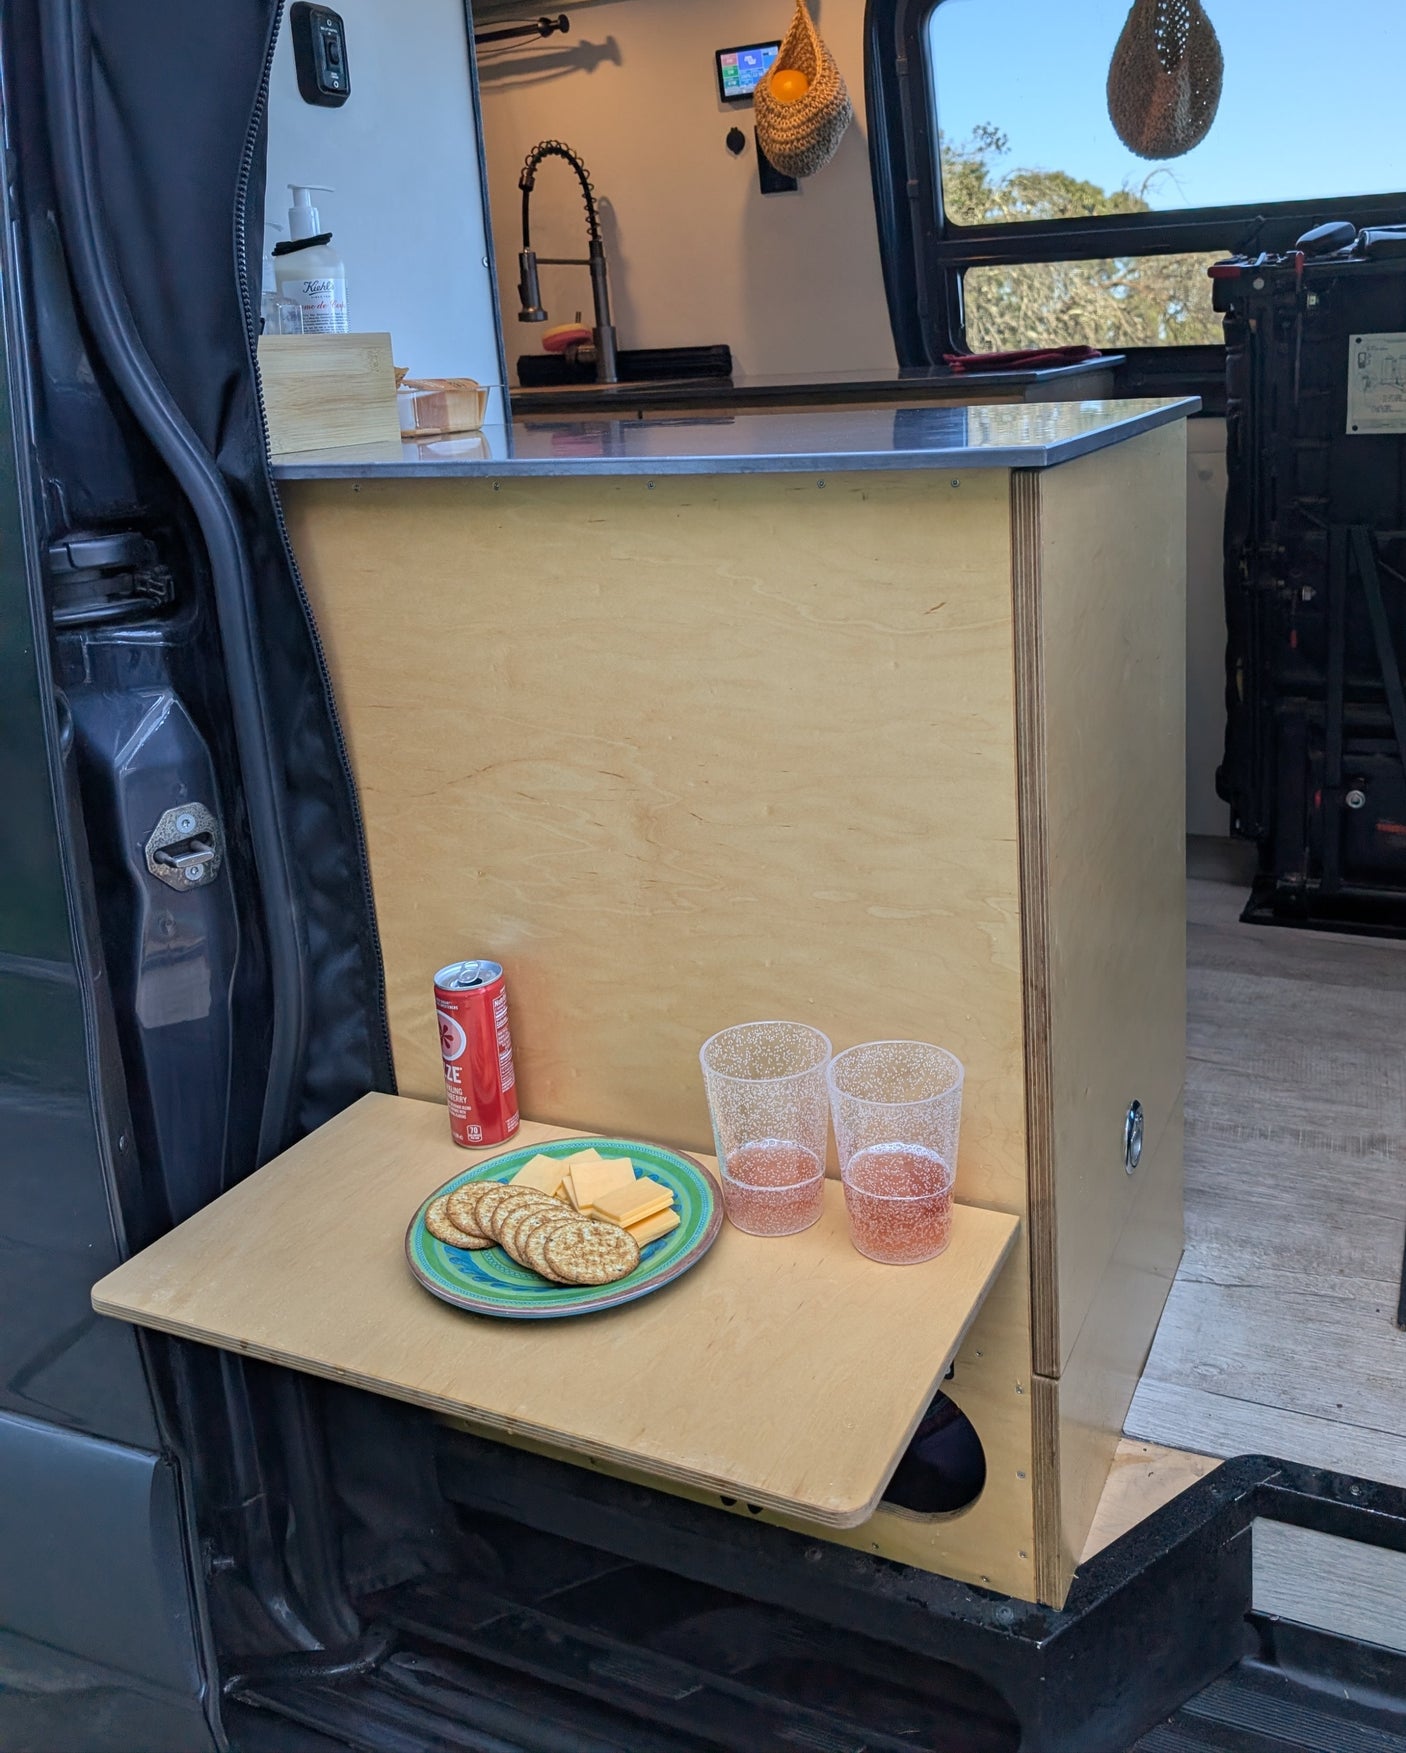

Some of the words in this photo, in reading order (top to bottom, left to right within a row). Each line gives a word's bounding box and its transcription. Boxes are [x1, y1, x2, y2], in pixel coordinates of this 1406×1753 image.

[302, 280, 335, 293] Kiehl's
[445, 1064, 462, 1083] ZE
[447, 1092, 467, 1104] BERRY
[470, 1126, 478, 1134] 70
